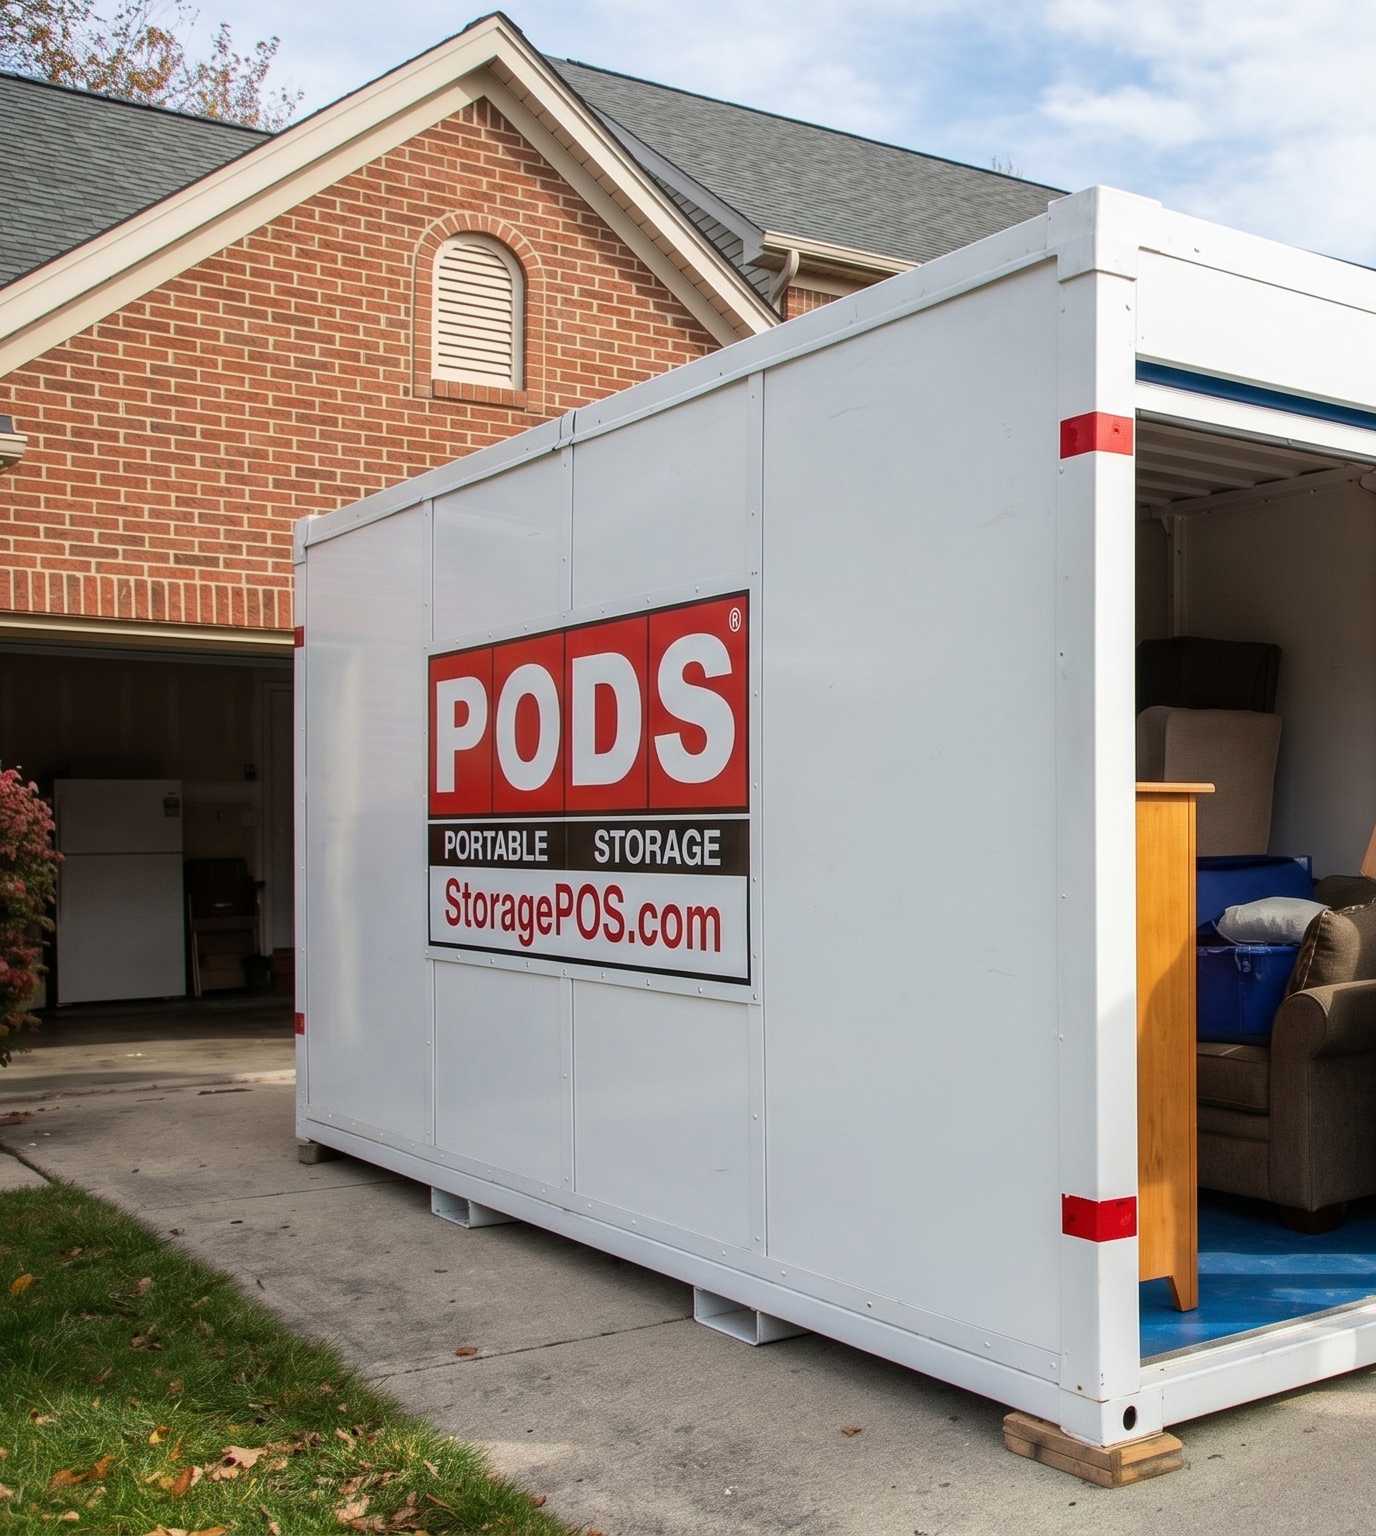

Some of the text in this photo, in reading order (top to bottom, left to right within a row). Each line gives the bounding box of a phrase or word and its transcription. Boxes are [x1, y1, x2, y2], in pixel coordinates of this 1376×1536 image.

[436, 632, 735, 793] PODS
[444, 829, 721, 866] PORTABLE STORAGE
[445, 878, 721, 952] StoragePOS.com
